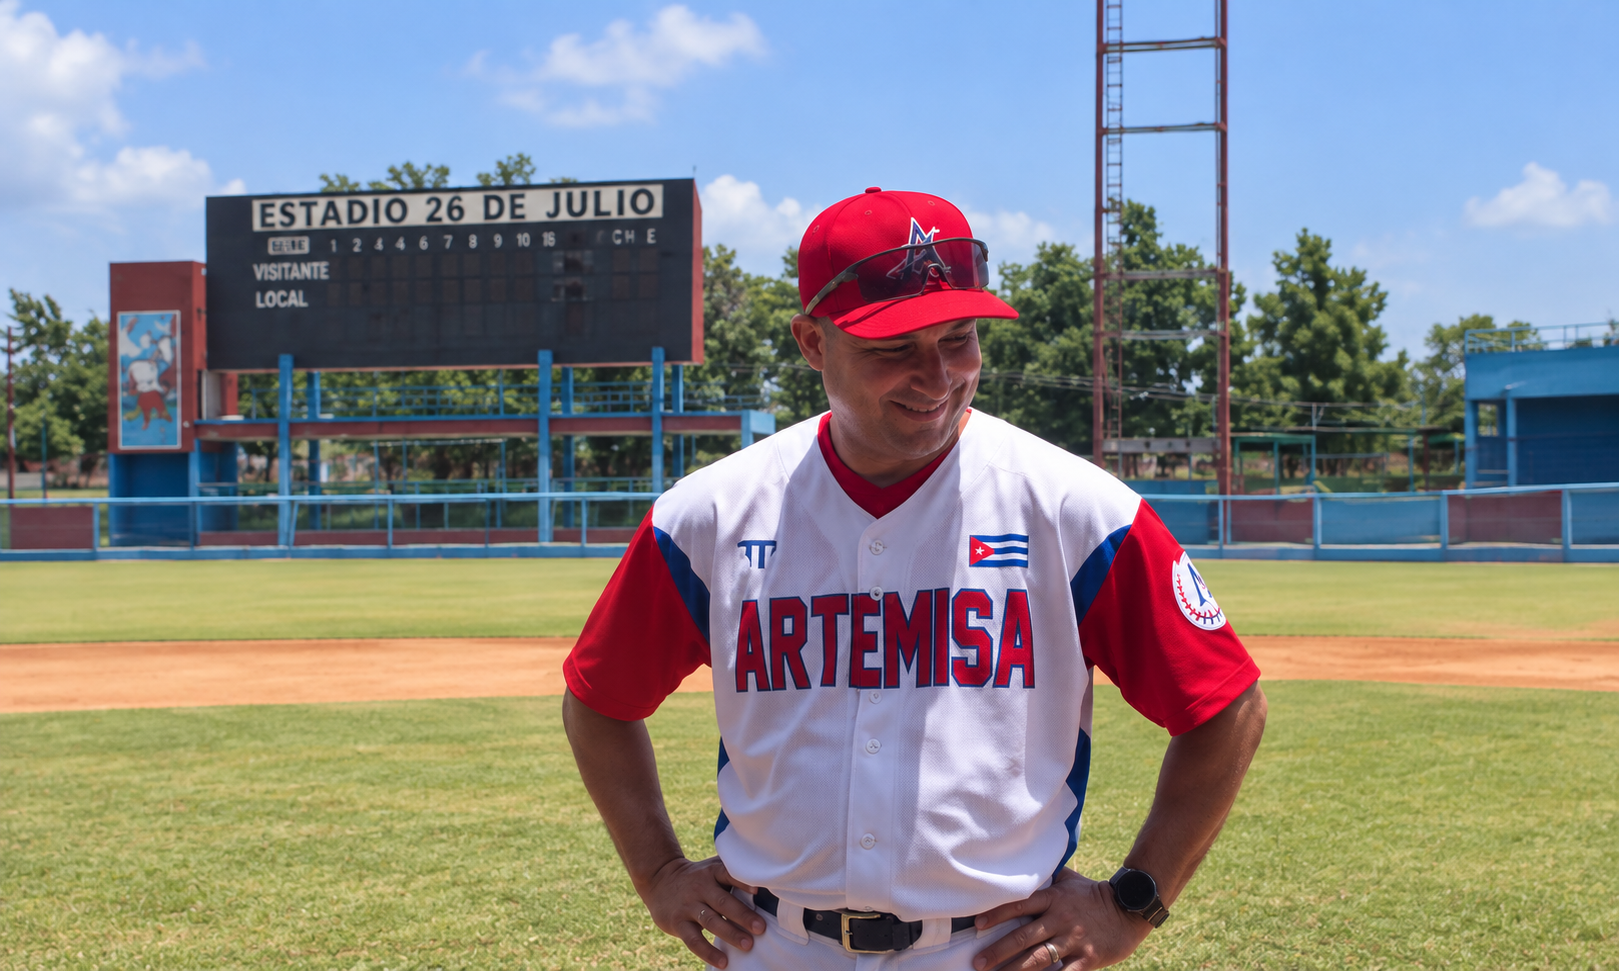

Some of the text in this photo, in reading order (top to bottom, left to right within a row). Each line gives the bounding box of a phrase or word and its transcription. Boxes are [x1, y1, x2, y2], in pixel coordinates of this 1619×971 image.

[259, 188, 654, 228] ESTADIO 26 DE JULIO
[329, 239, 337, 253] 1
[352, 237, 362, 253] 2
[418, 235, 429, 251] 6
[443, 234, 454, 249] 7
[468, 233, 478, 249] 8
[493, 232, 503, 248] 9
[516, 232, 531, 248] 10
[252, 261, 330, 281] VISITANTE
[255, 289, 309, 309] LOCAL
[735, 587, 1036, 692] ARTEMISA
